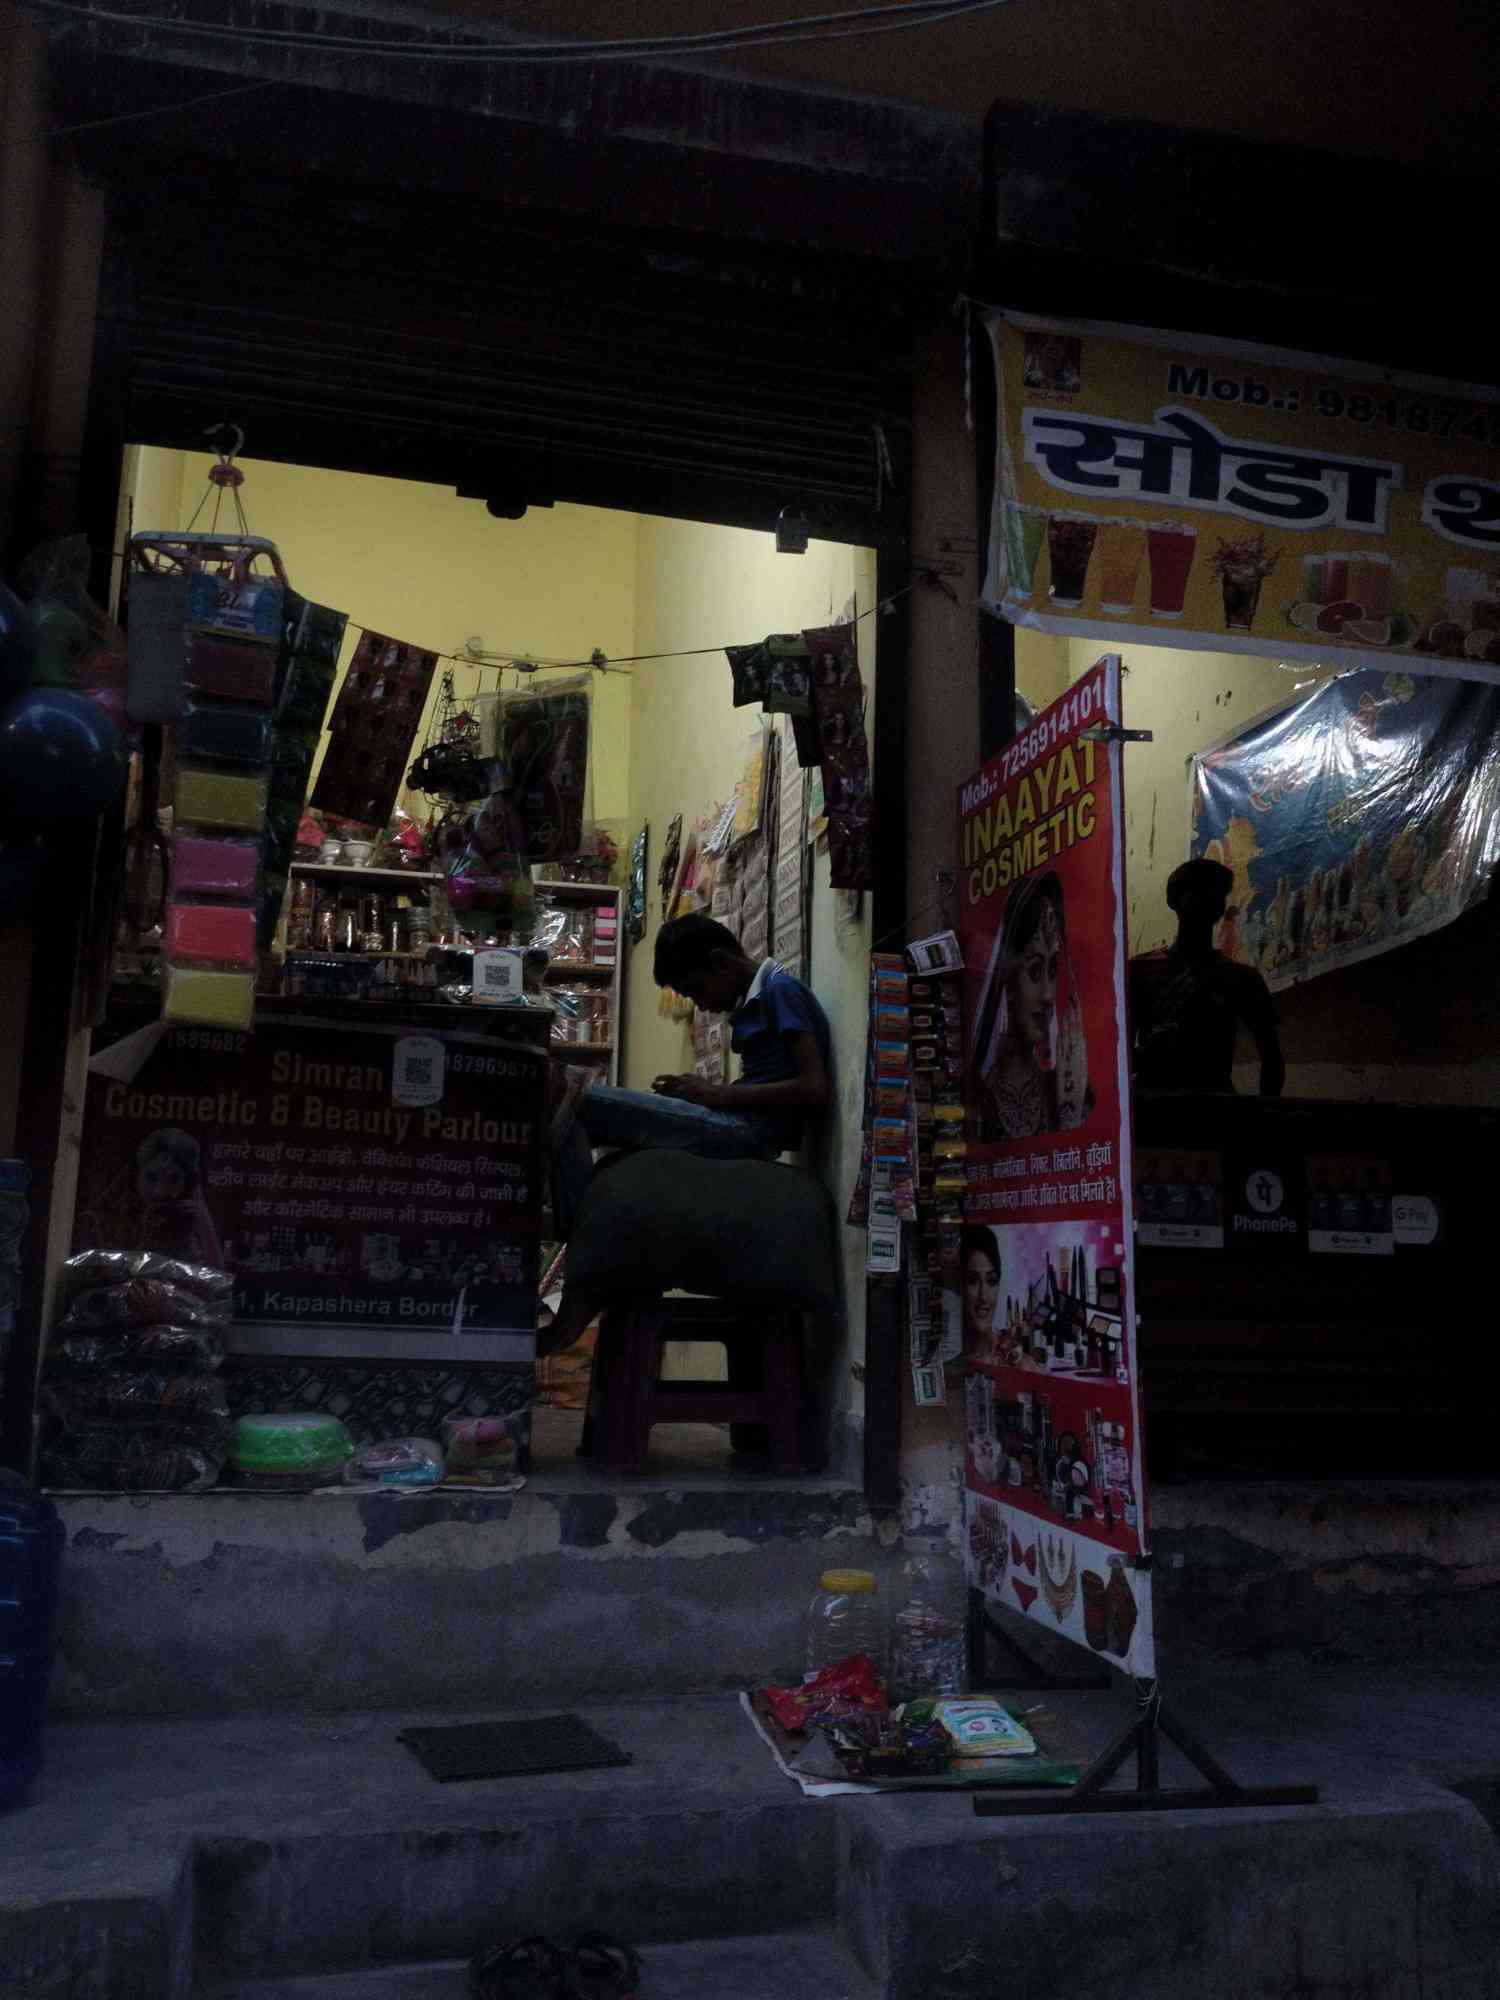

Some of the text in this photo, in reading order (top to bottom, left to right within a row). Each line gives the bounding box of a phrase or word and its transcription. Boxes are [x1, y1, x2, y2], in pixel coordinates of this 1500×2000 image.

[1317, 388, 1500, 445] 981874
[1033, 411, 1393, 523] सोडा
[1001, 675, 1103, 783] 7256914101
[962, 720, 1104, 867] INAAYAT
[967, 791, 1096, 905] COSMETIC
[272, 1050, 384, 1091] Simran
[104, 1085, 534, 1144] Cosmetic & Beauty Parlour
[1233, 1213, 1297, 1232] PhonePe
[264, 1289, 392, 1317] Kapashera
